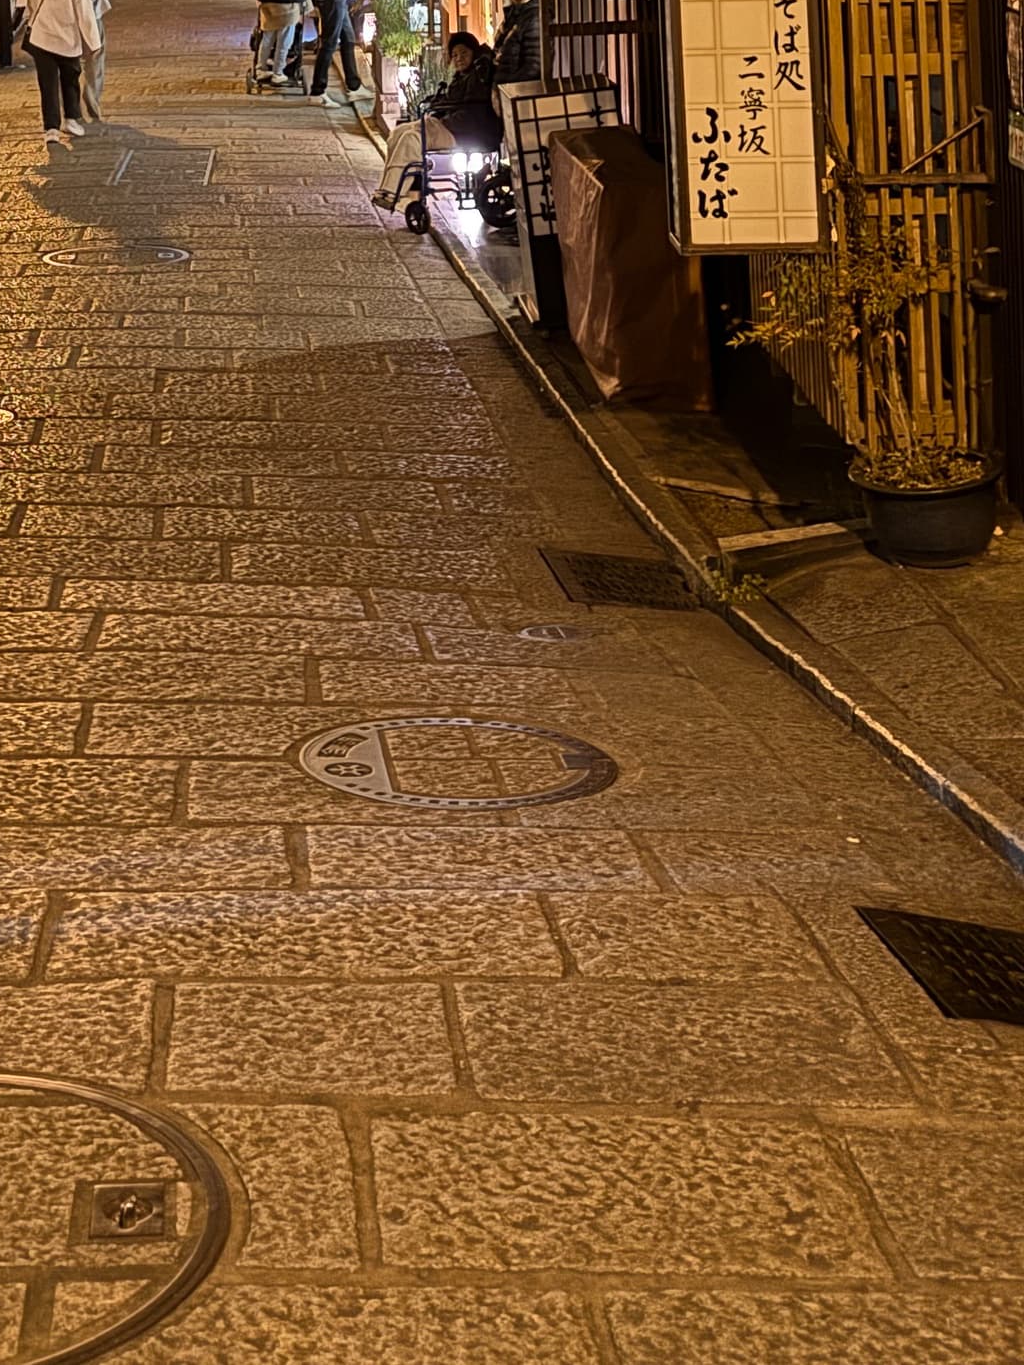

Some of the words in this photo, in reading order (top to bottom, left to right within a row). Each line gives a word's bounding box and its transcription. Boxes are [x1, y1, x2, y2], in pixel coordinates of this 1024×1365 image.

[738, 55, 771, 156] 二寧坂
[691, 107, 738, 219] ふたば
